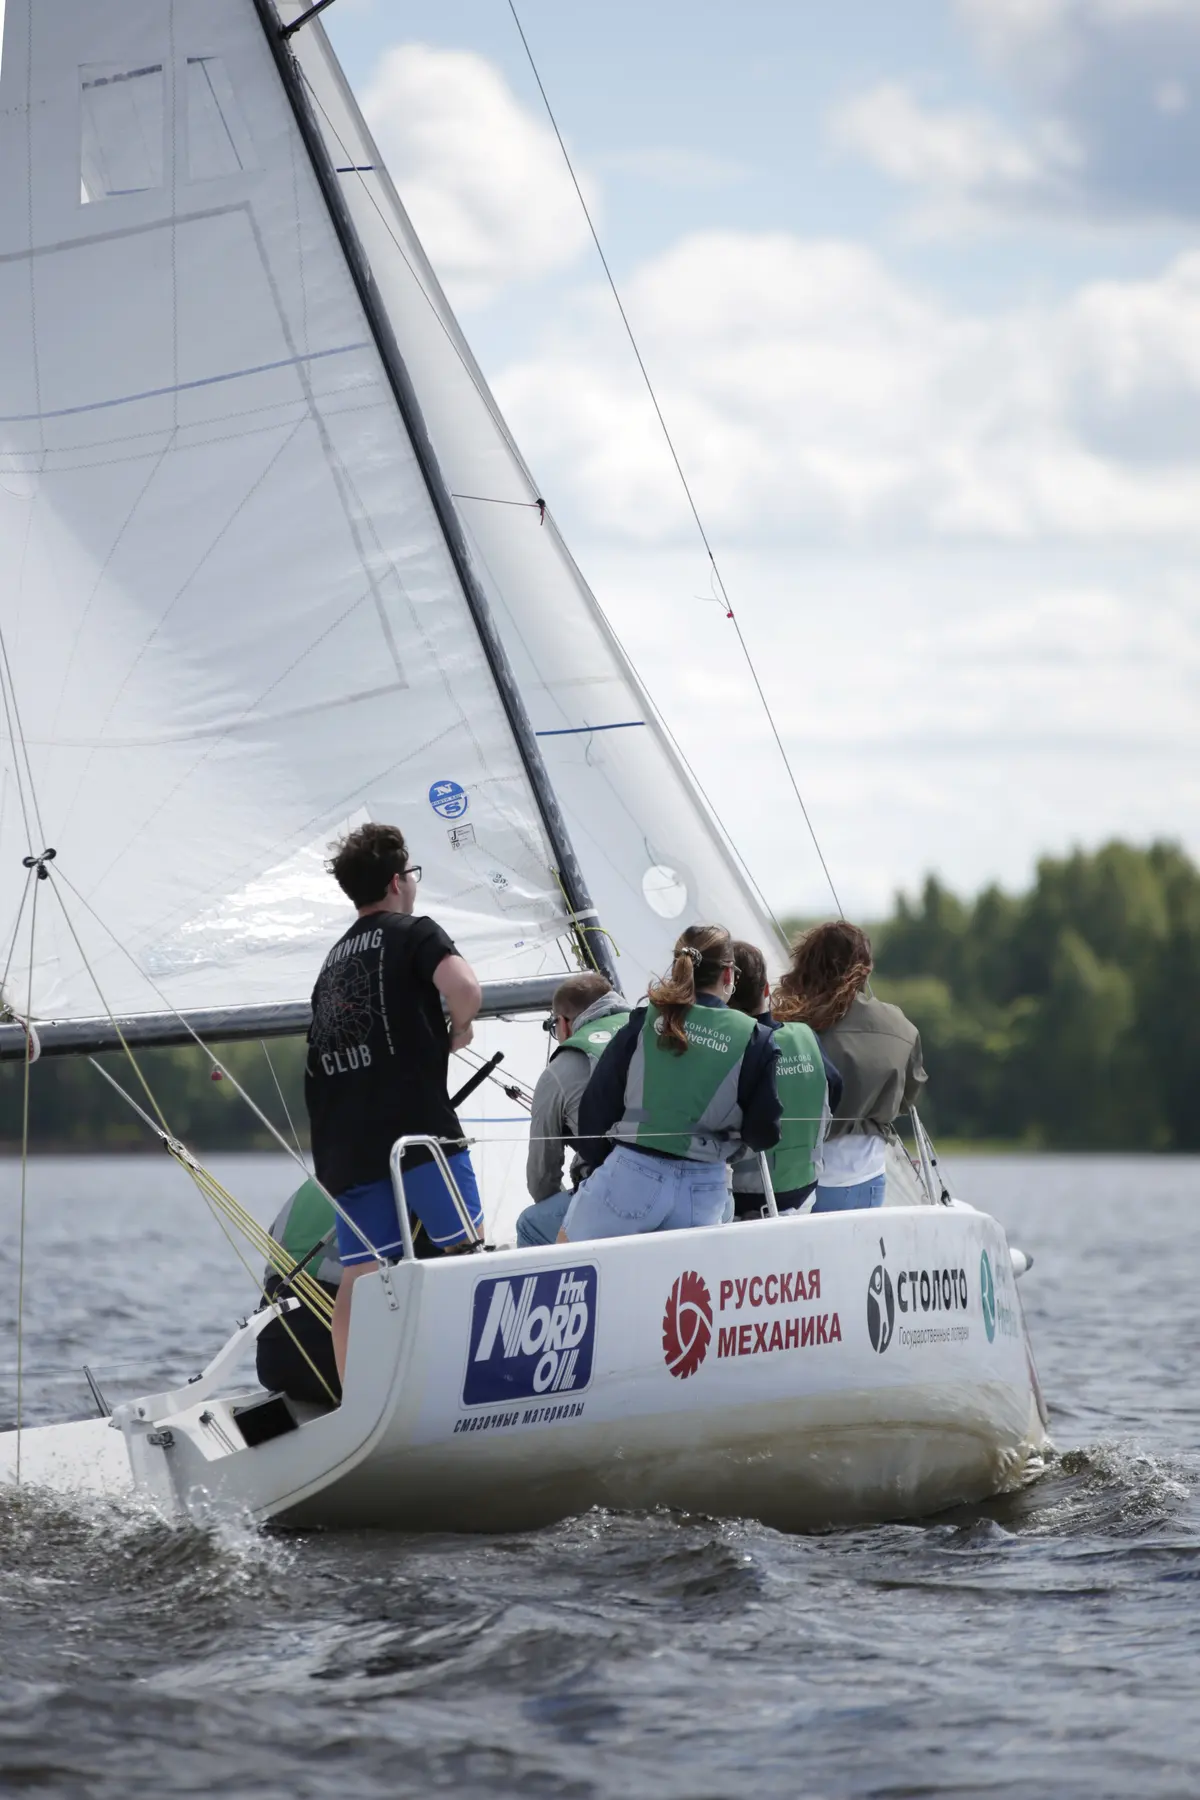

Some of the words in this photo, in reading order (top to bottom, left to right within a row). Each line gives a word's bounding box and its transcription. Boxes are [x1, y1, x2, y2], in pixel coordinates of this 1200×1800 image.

[433, 783, 453, 797] N
[444, 801, 461, 814] S
[321, 1044, 372, 1076] CLUB
[776, 1062, 815, 1076] RiverClub
[777, 1054, 812, 1065] ОНАКОВО
[720, 1268, 821, 1311] РУССКАЯ
[474, 1276, 589, 1362] NORD
[717, 1312, 842, 1358] МЕХАНИКА
[533, 1349, 580, 1393] OIL
